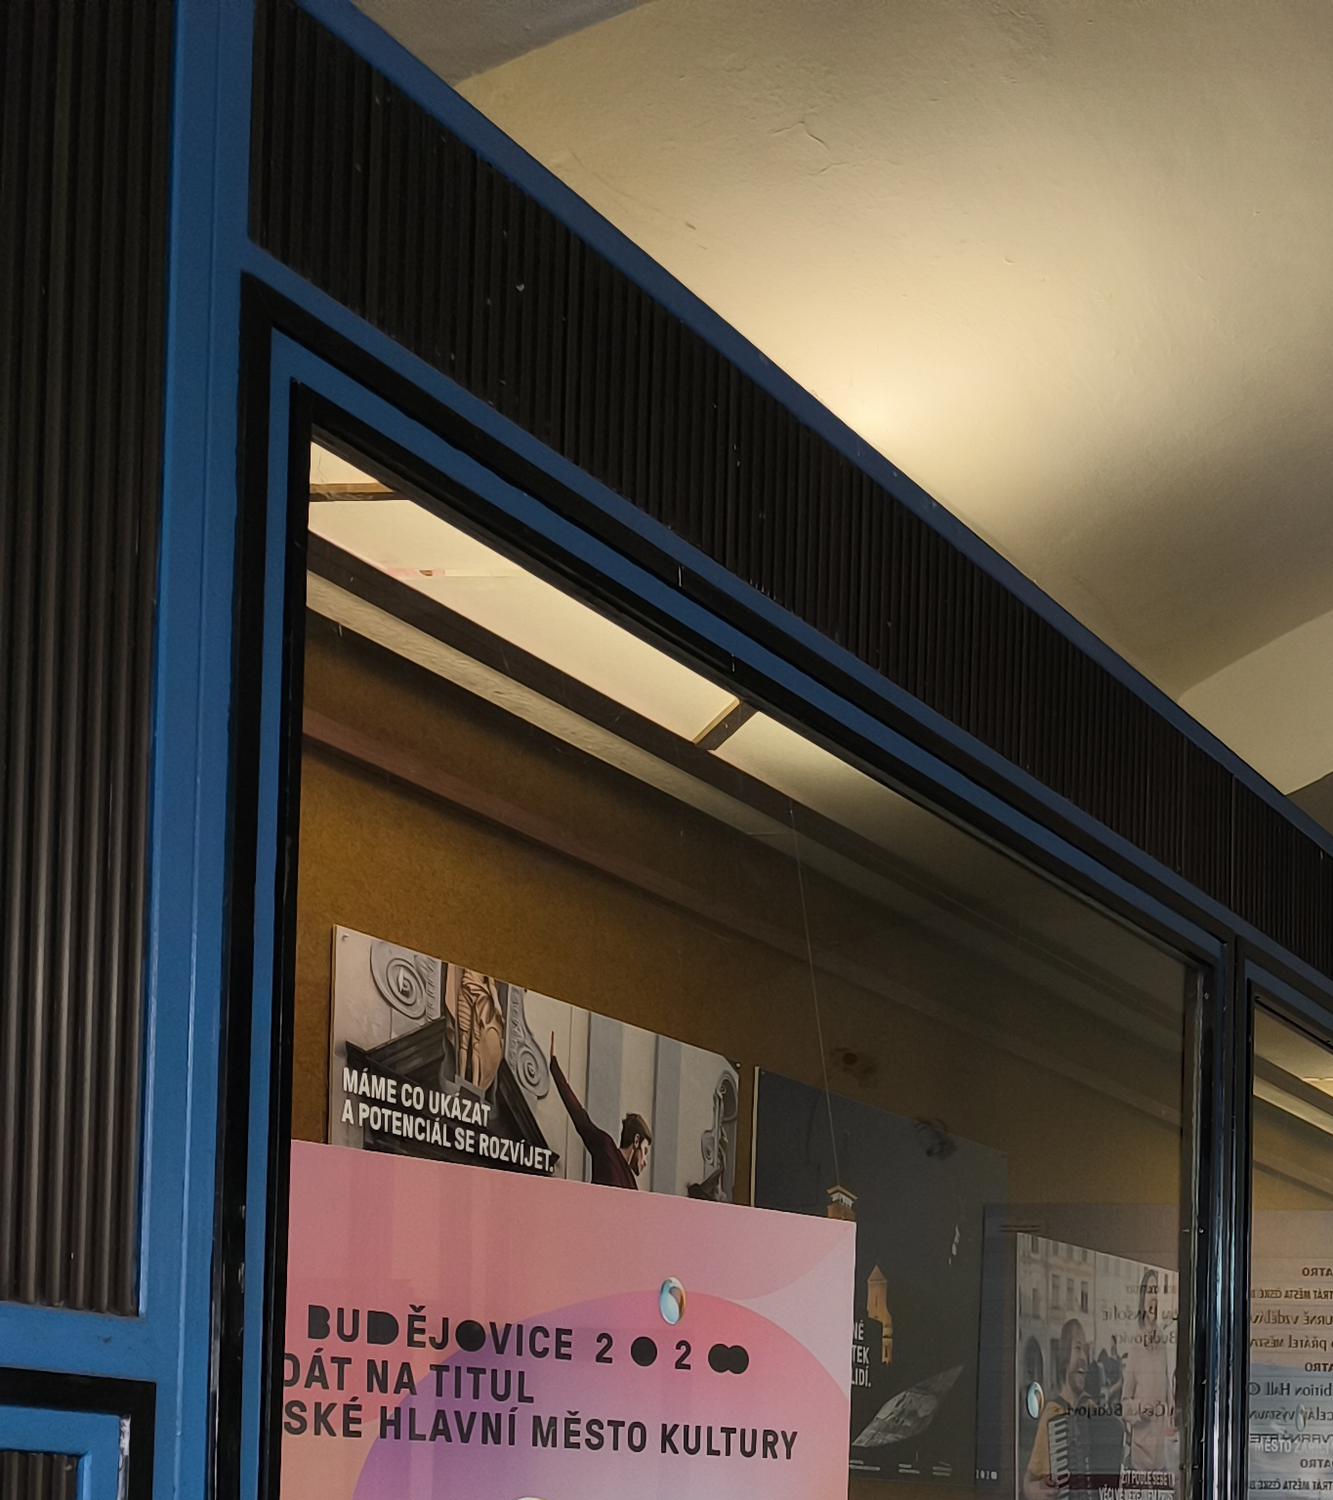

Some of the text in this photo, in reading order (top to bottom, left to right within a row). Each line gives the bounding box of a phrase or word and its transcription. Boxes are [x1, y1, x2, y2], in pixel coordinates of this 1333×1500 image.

[343, 1067, 491, 1126] MÁME CO UKÁZAT
[341, 1099, 555, 1172] A POTENCIÁL SE ROZVÍJET.
[308, 1305, 572, 1361] BUDĚJOVICE
[366, 1360, 416, 1395] NA
[430, 1364, 534, 1404] TITUL
[379, 1407, 517, 1446] HLAVNÍ
[532, 1410, 647, 1453] MĚSTO
[660, 1422, 798, 1460] KULTURY
